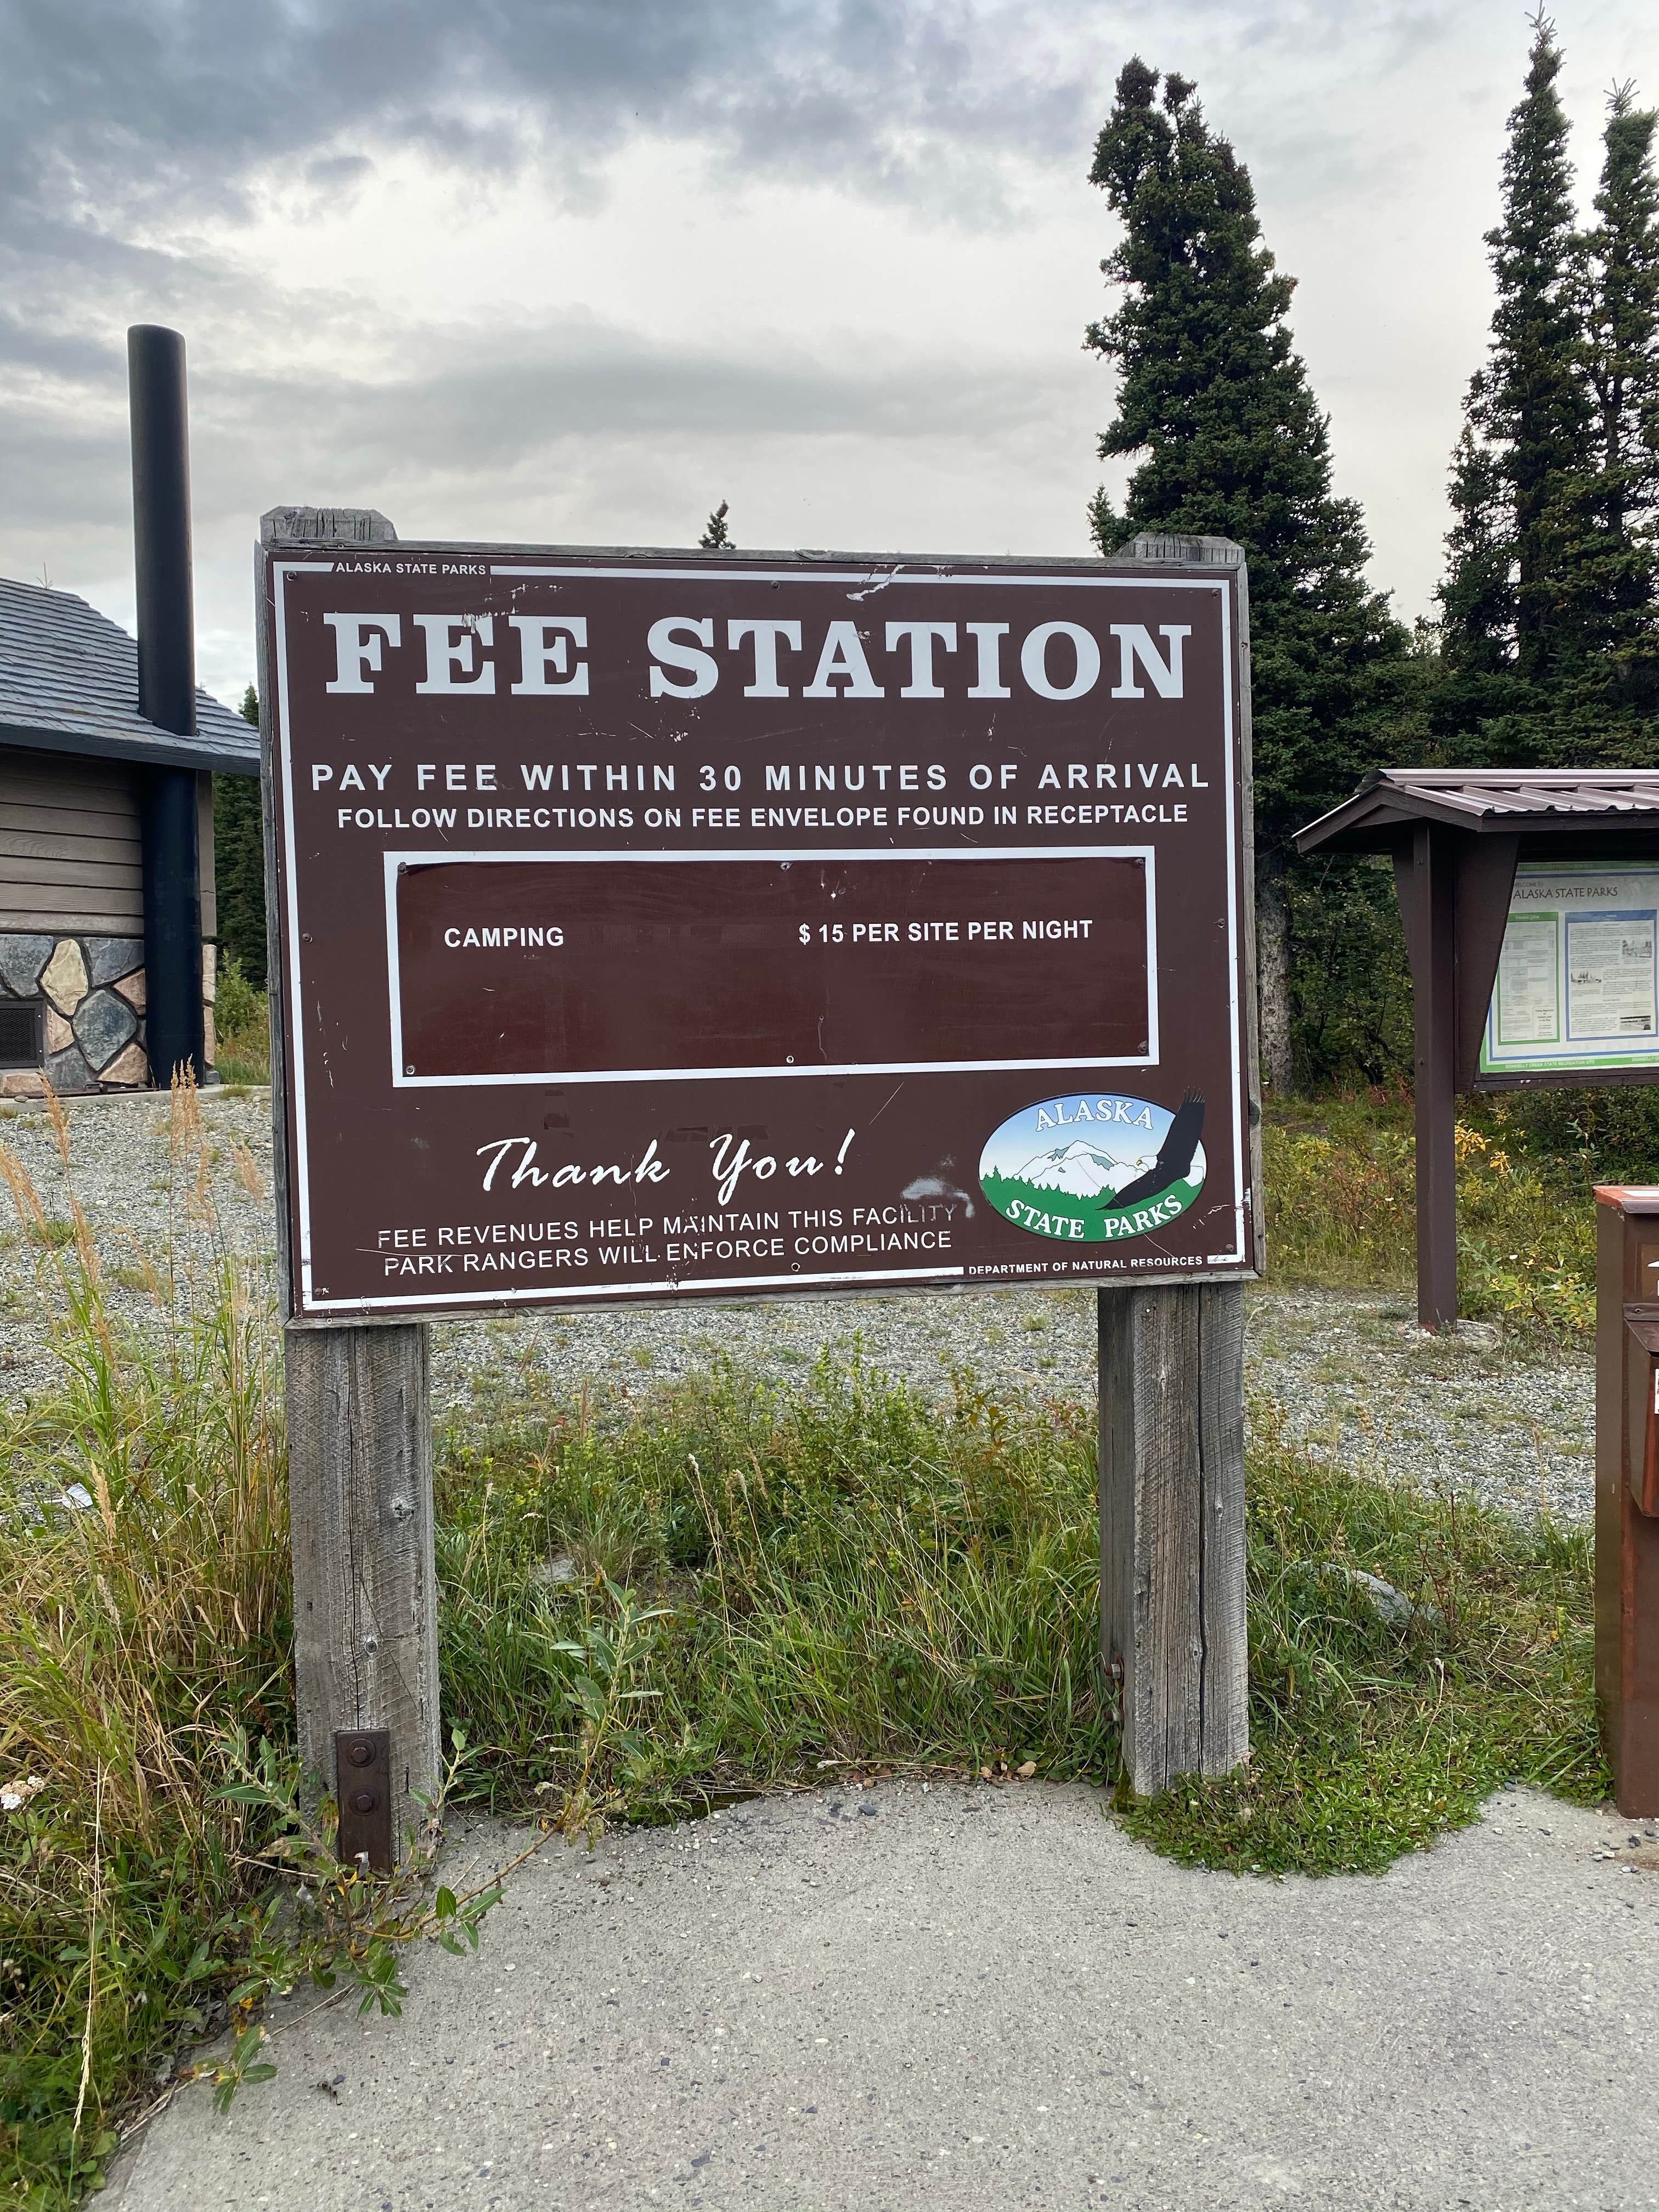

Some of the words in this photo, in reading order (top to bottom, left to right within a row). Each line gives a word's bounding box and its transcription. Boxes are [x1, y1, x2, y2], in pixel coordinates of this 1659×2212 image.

[336, 562, 391, 572] ALASKA
[396, 563, 437, 573] STATE
[443, 565, 486, 574] PARKS
[324, 613, 589, 695] FEE
[647, 617, 1191, 700] STATION
[312, 765, 392, 790] PAY
[417, 765, 496, 790] FEE
[521, 765, 674, 790] WITHIN
[700, 766, 741, 791] 30
[766, 765, 946, 790] MINUTES
[969, 765, 1017, 789] OF
[1038, 764, 1208, 788] ARRIVAL
[338, 809, 456, 828] FOLLOW
[468, 809, 633, 827] DIRECTIONS
[645, 809, 680, 827] ON
[693, 809, 740, 826] FEE
[752, 808, 887, 826] ENVELOPE
[898, 807, 984, 825] FOUND
[995, 806, 1016, 824] IN
[1028, 804, 1187, 823] RECEPTACLE
[1514, 889, 1553, 899] ALASKA
[1555, 888, 1584, 898] STATE
[1587, 887, 1618, 896] PARKS
[445, 927, 563, 947] CAMPING
[799, 923, 810, 945] $
[819, 924, 843, 942] 15
[853, 924, 900, 941] PER
[909, 923, 958, 941] SITE
[969, 922, 1014, 940] PER
[1023, 920, 1092, 939] NIGHT
[1036, 1099, 1153, 1131] ALASKA
[477, 1137, 670, 1191] Thank
[710, 1128, 855, 1206] You!
[379, 1229, 426, 1248] FEE
[439, 1222, 578, 1245] REVENUES
[590, 1218, 653, 1238] HELP
[664, 1212, 778, 1234] MAINTAIN
[788, 1210, 842, 1228] THIS
[854, 1204, 957, 1226] FACILITY
[1006, 1200, 1084, 1238] STATE
[1104, 1195, 1182, 1237] PARKS
[385, 1256, 454, 1276] PARK
[464, 1248, 588, 1271] RANGERS
[599, 1245, 657, 1264] WILL
[667, 1239, 784, 1261] ENFORCE
[795, 1231, 951, 1254] COMPLIANCE
[969, 1263, 1048, 1274] DEPARTMENT
[1053, 1262, 1068, 1271] OF
[1073, 1260, 1127, 1270] NATURAL
[1131, 1256, 1203, 1267] RESOURCES
